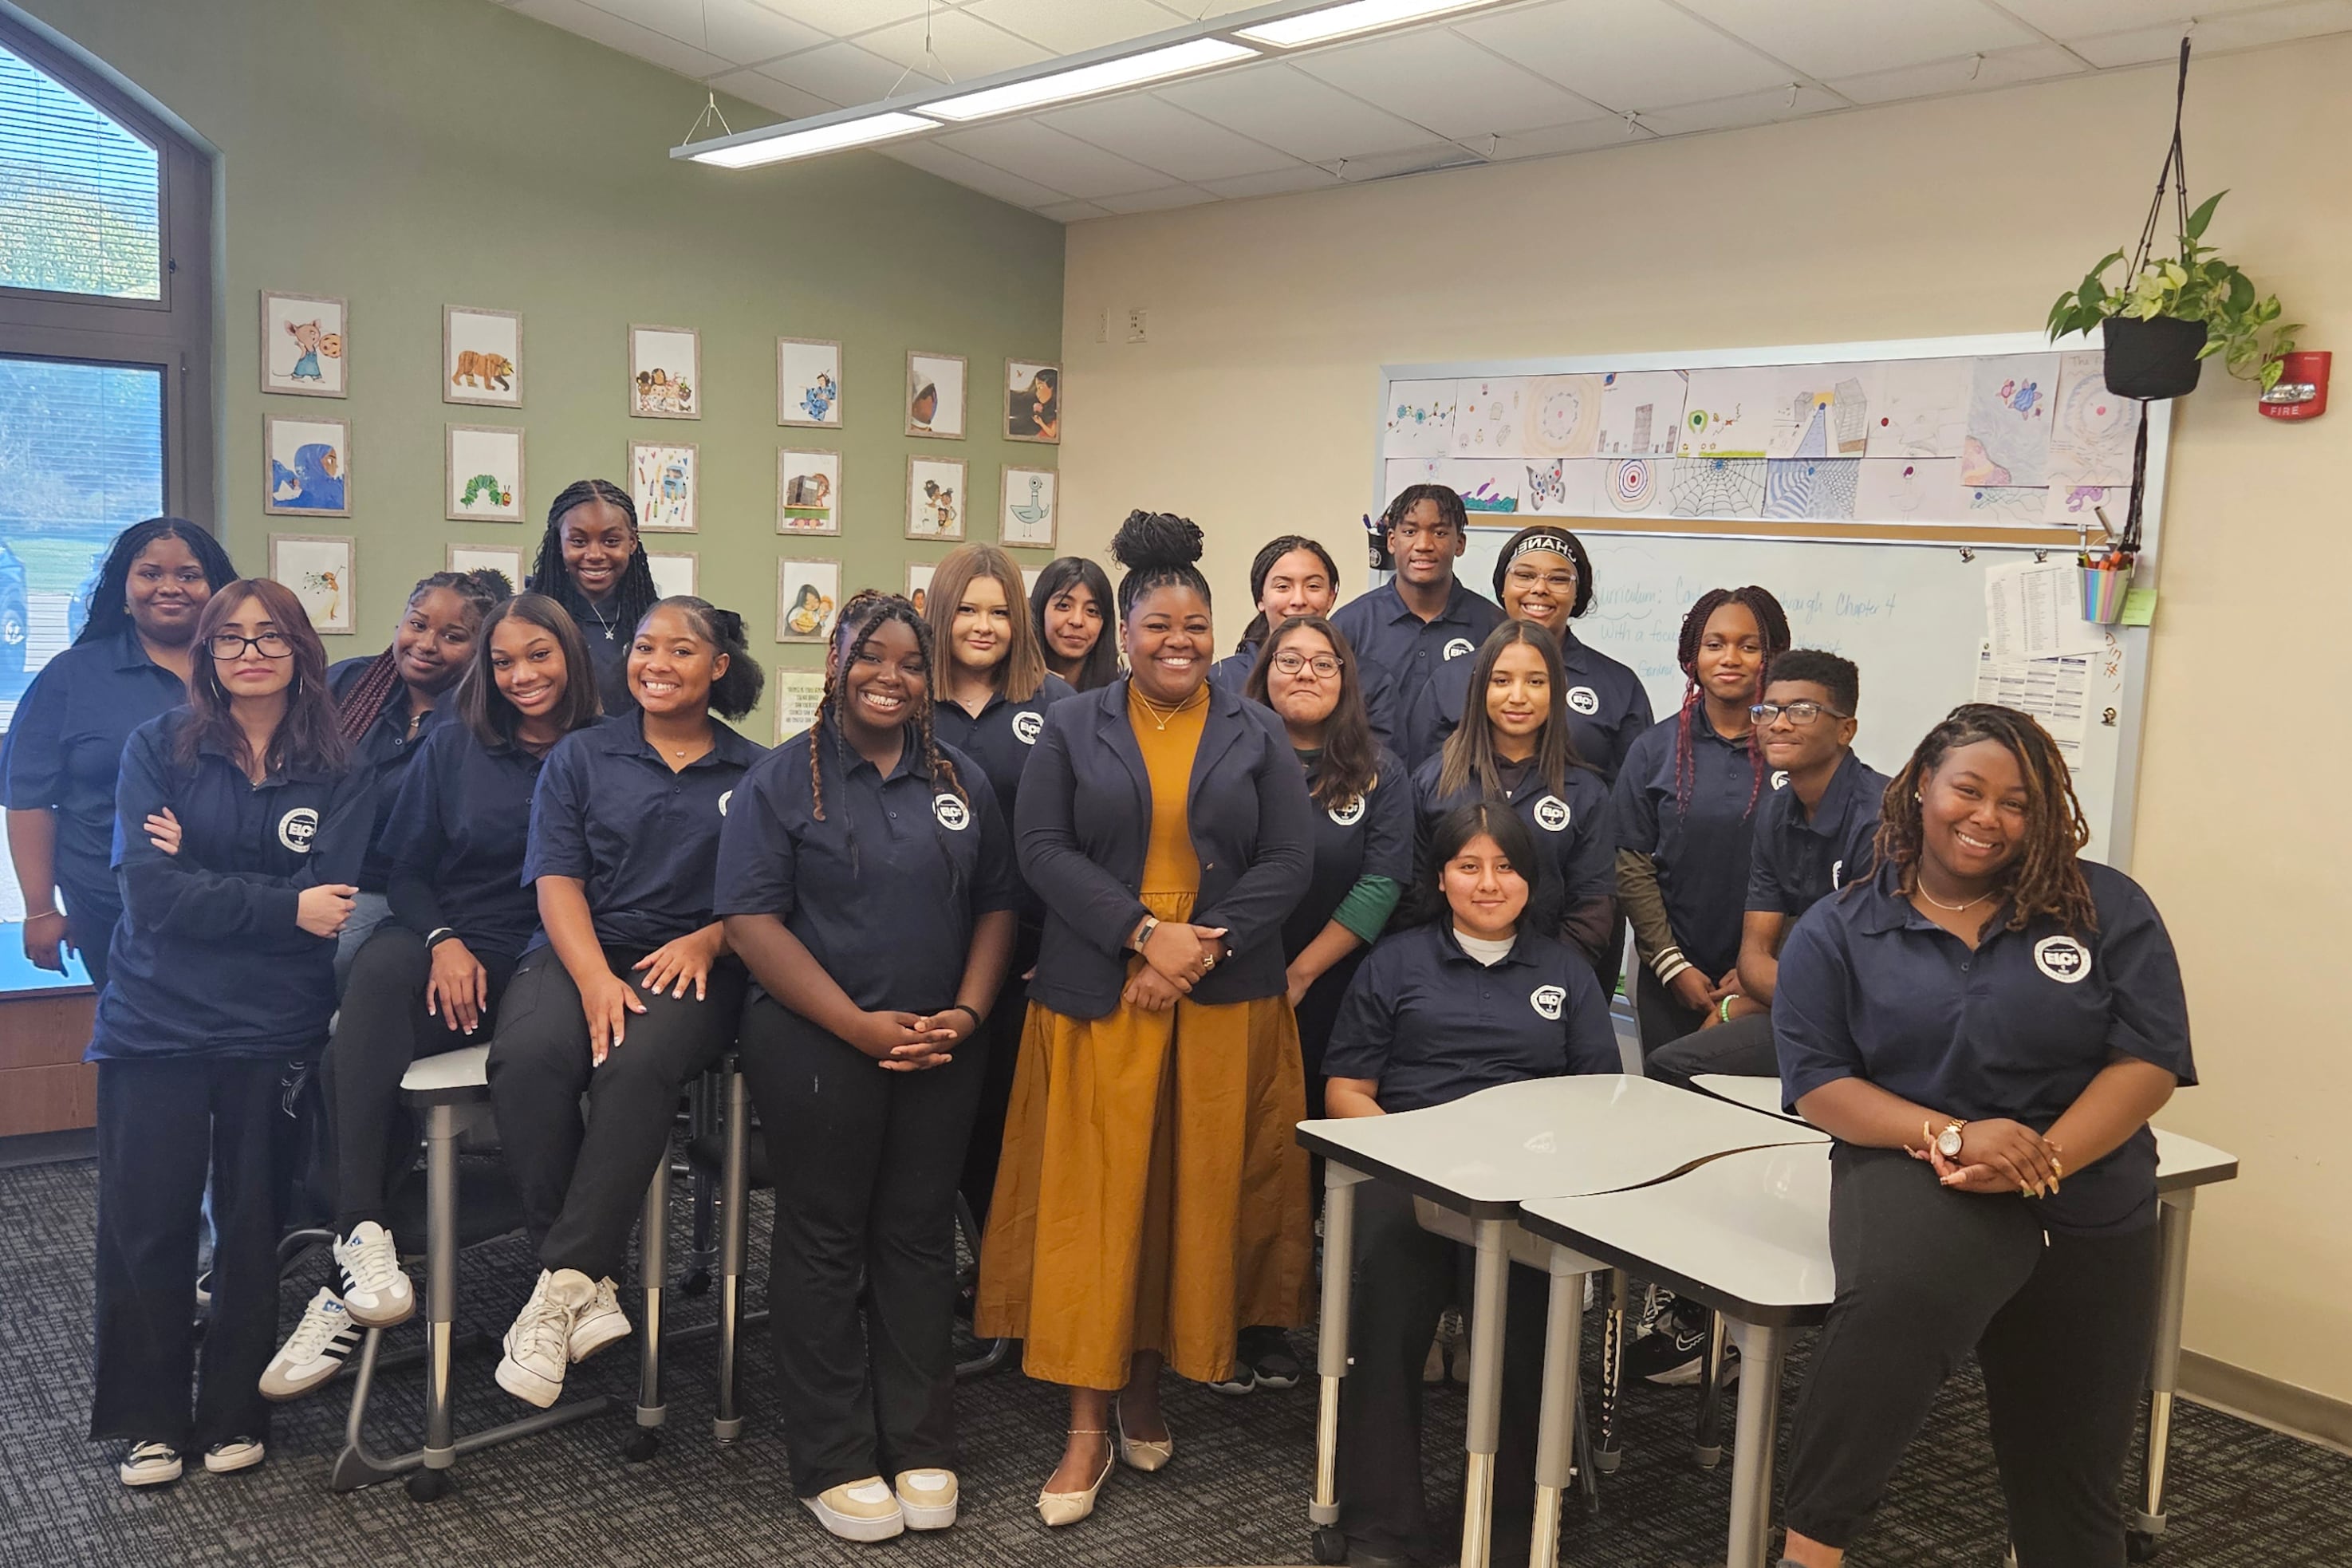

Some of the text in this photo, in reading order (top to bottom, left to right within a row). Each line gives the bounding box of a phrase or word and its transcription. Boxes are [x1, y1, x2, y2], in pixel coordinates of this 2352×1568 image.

[2271, 406, 2299, 416] FIRE
[1836, 593, 1880, 619] Chapter
[1885, 593, 1897, 619] 4
